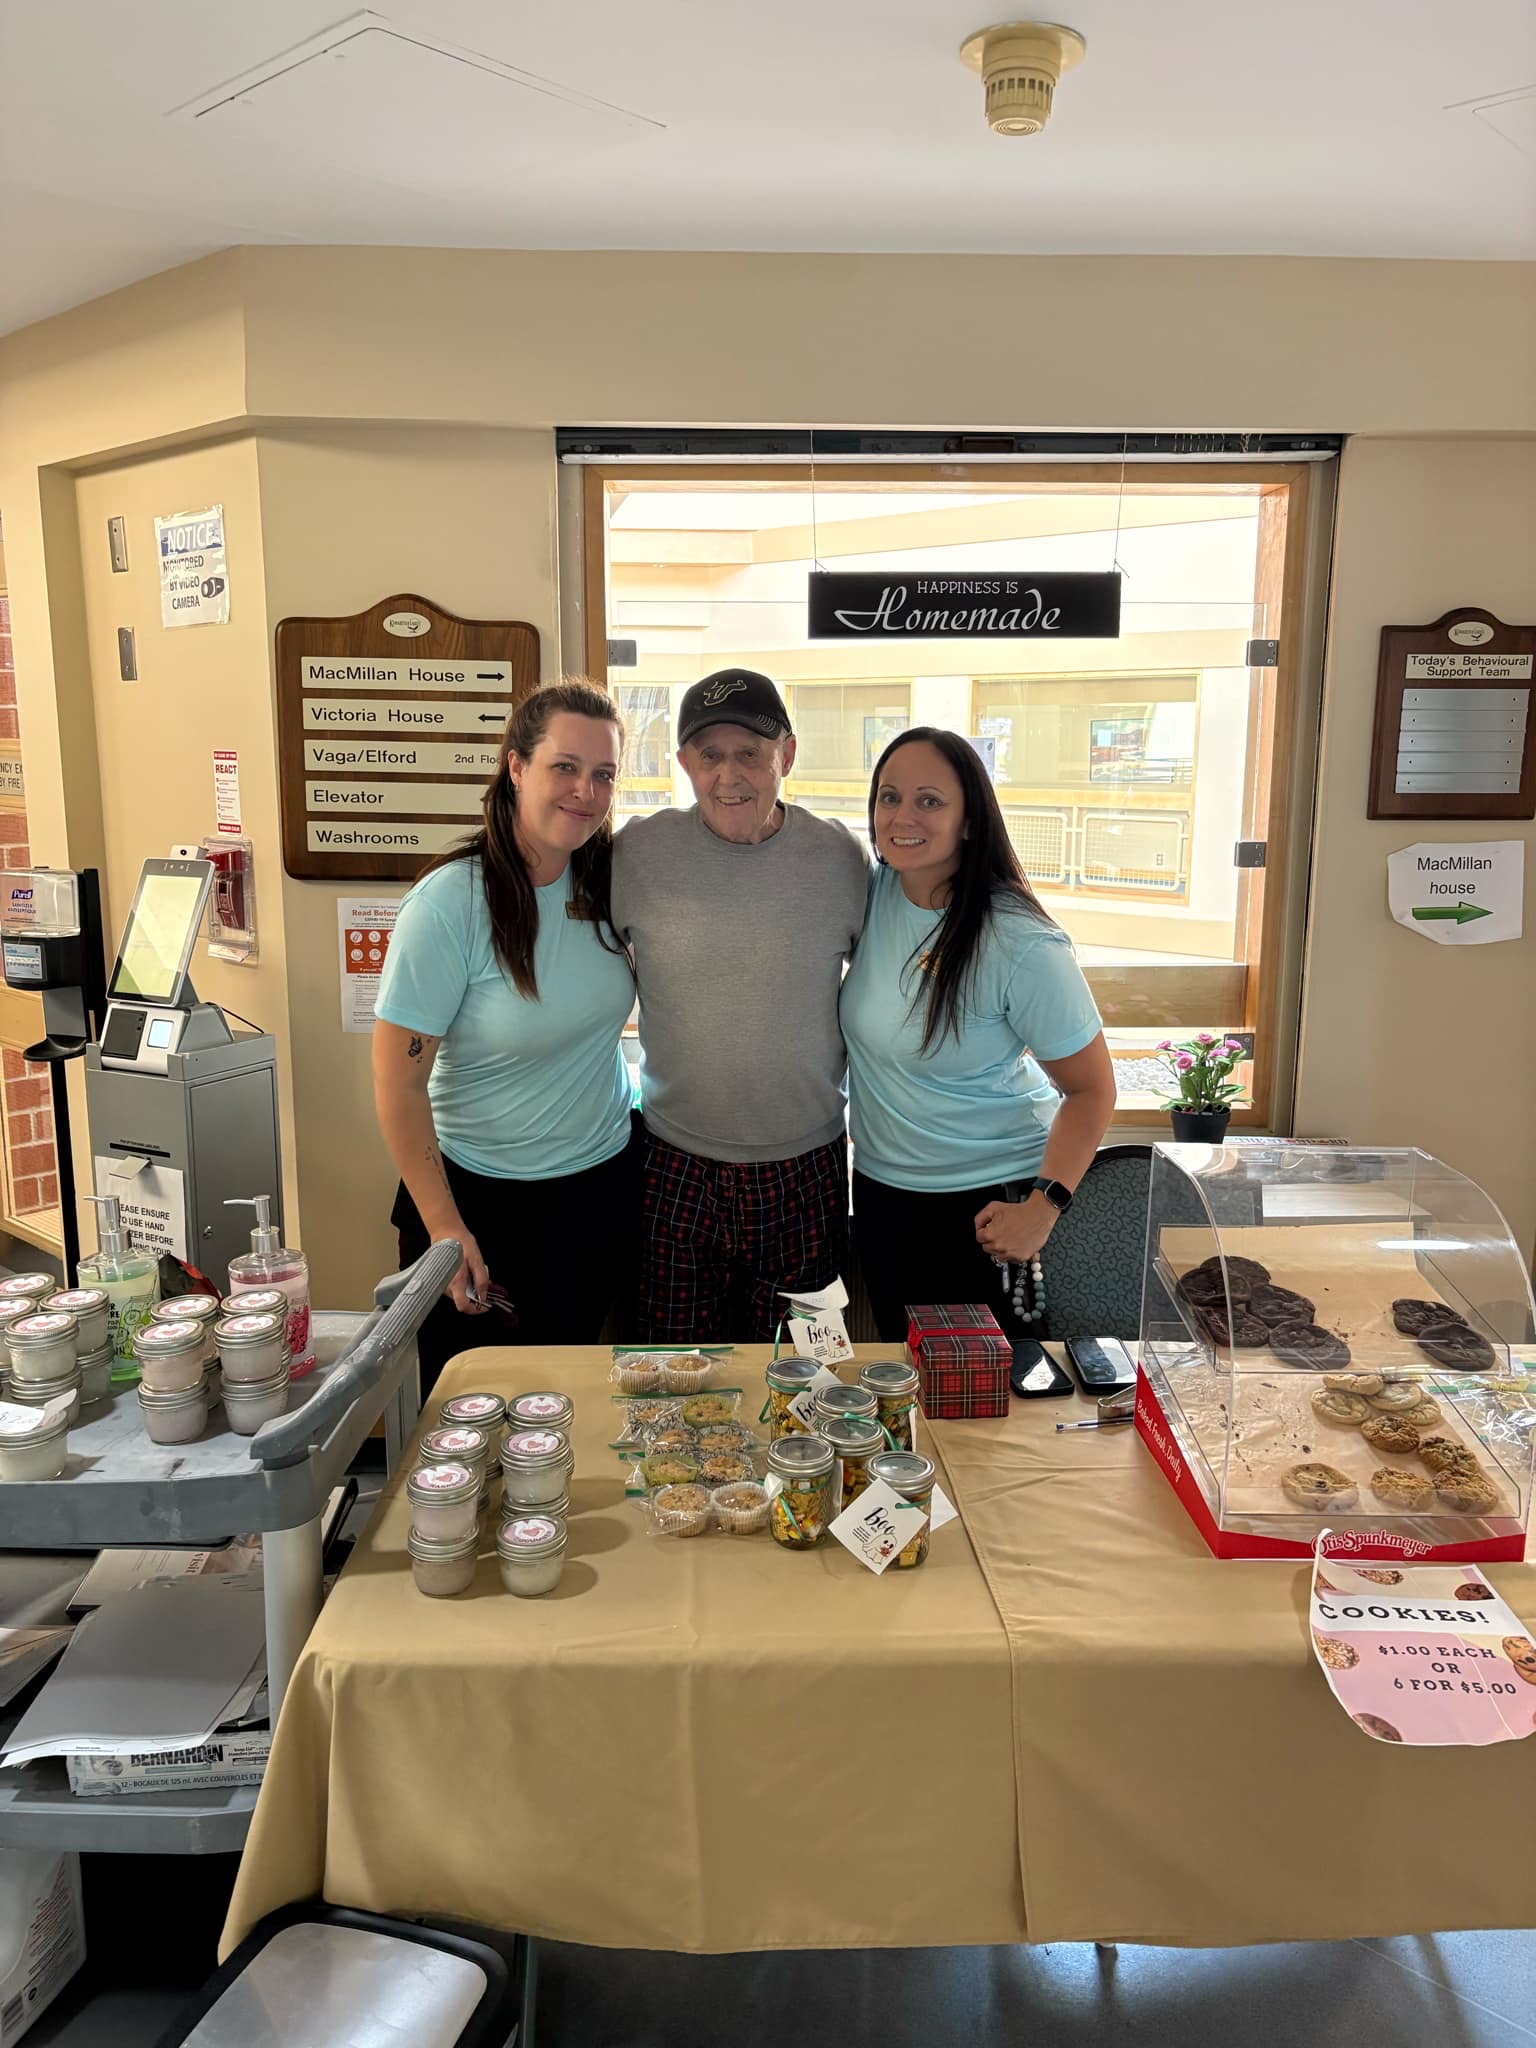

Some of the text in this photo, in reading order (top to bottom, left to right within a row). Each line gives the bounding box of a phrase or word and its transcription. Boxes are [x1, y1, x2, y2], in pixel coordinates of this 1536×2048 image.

[167, 523, 214, 552] NOTICE
[163, 555, 204, 573] MONITORED
[169, 575, 200, 591] BY VIDEO
[917, 581, 1019, 594] HAPPINESS IS
[172, 595, 201, 610] CAMERA
[833, 585, 1062, 631] Homemade
[1411, 655, 1529, 667] Today's Behavioural
[309, 665, 465, 682] MacMillan House
[1427, 666, 1510, 678] Support Team
[311, 707, 444, 723] Victoria House
[313, 748, 417, 764] Vaga/Elford
[455, 753, 474, 764] 2nd
[215, 764, 237, 775] REACT
[314, 789, 384, 804] Elevator
[316, 830, 420, 845] Washrooms
[1417, 856, 1492, 871] MacMillan
[1430, 881, 1476, 894] house
[352, 909, 371, 917] Read
[120, 1204, 171, 1221] EASE ENSURE
[129, 1217, 144, 1227] USE
[145, 1220, 165, 1232] HAND
[145, 1232, 175, 1246] BEFORE
[152, 1247, 172, 1256] YOUR
[806, 1324, 831, 1345] Boo
[863, 1506, 896, 1535] Boo
[1311, 1529, 1433, 1557] Otis Spunkmeyer
[186, 1552, 204, 1573] visit
[1318, 1603, 1490, 1624] COOKIES!
[1378, 1645, 1497, 1659] $1.00 EACH
[1431, 1662, 1462, 1674] OR
[1393, 1678, 1517, 1695] 6 FOR $5.00
[121, 1780, 128, 1788] 12
[171, 1777, 182, 1785] 125
[192, 1776, 209, 1784] AVEC
[210, 1774, 248, 1783] COUVERCLES
[250, 1773, 257, 1781] ET
